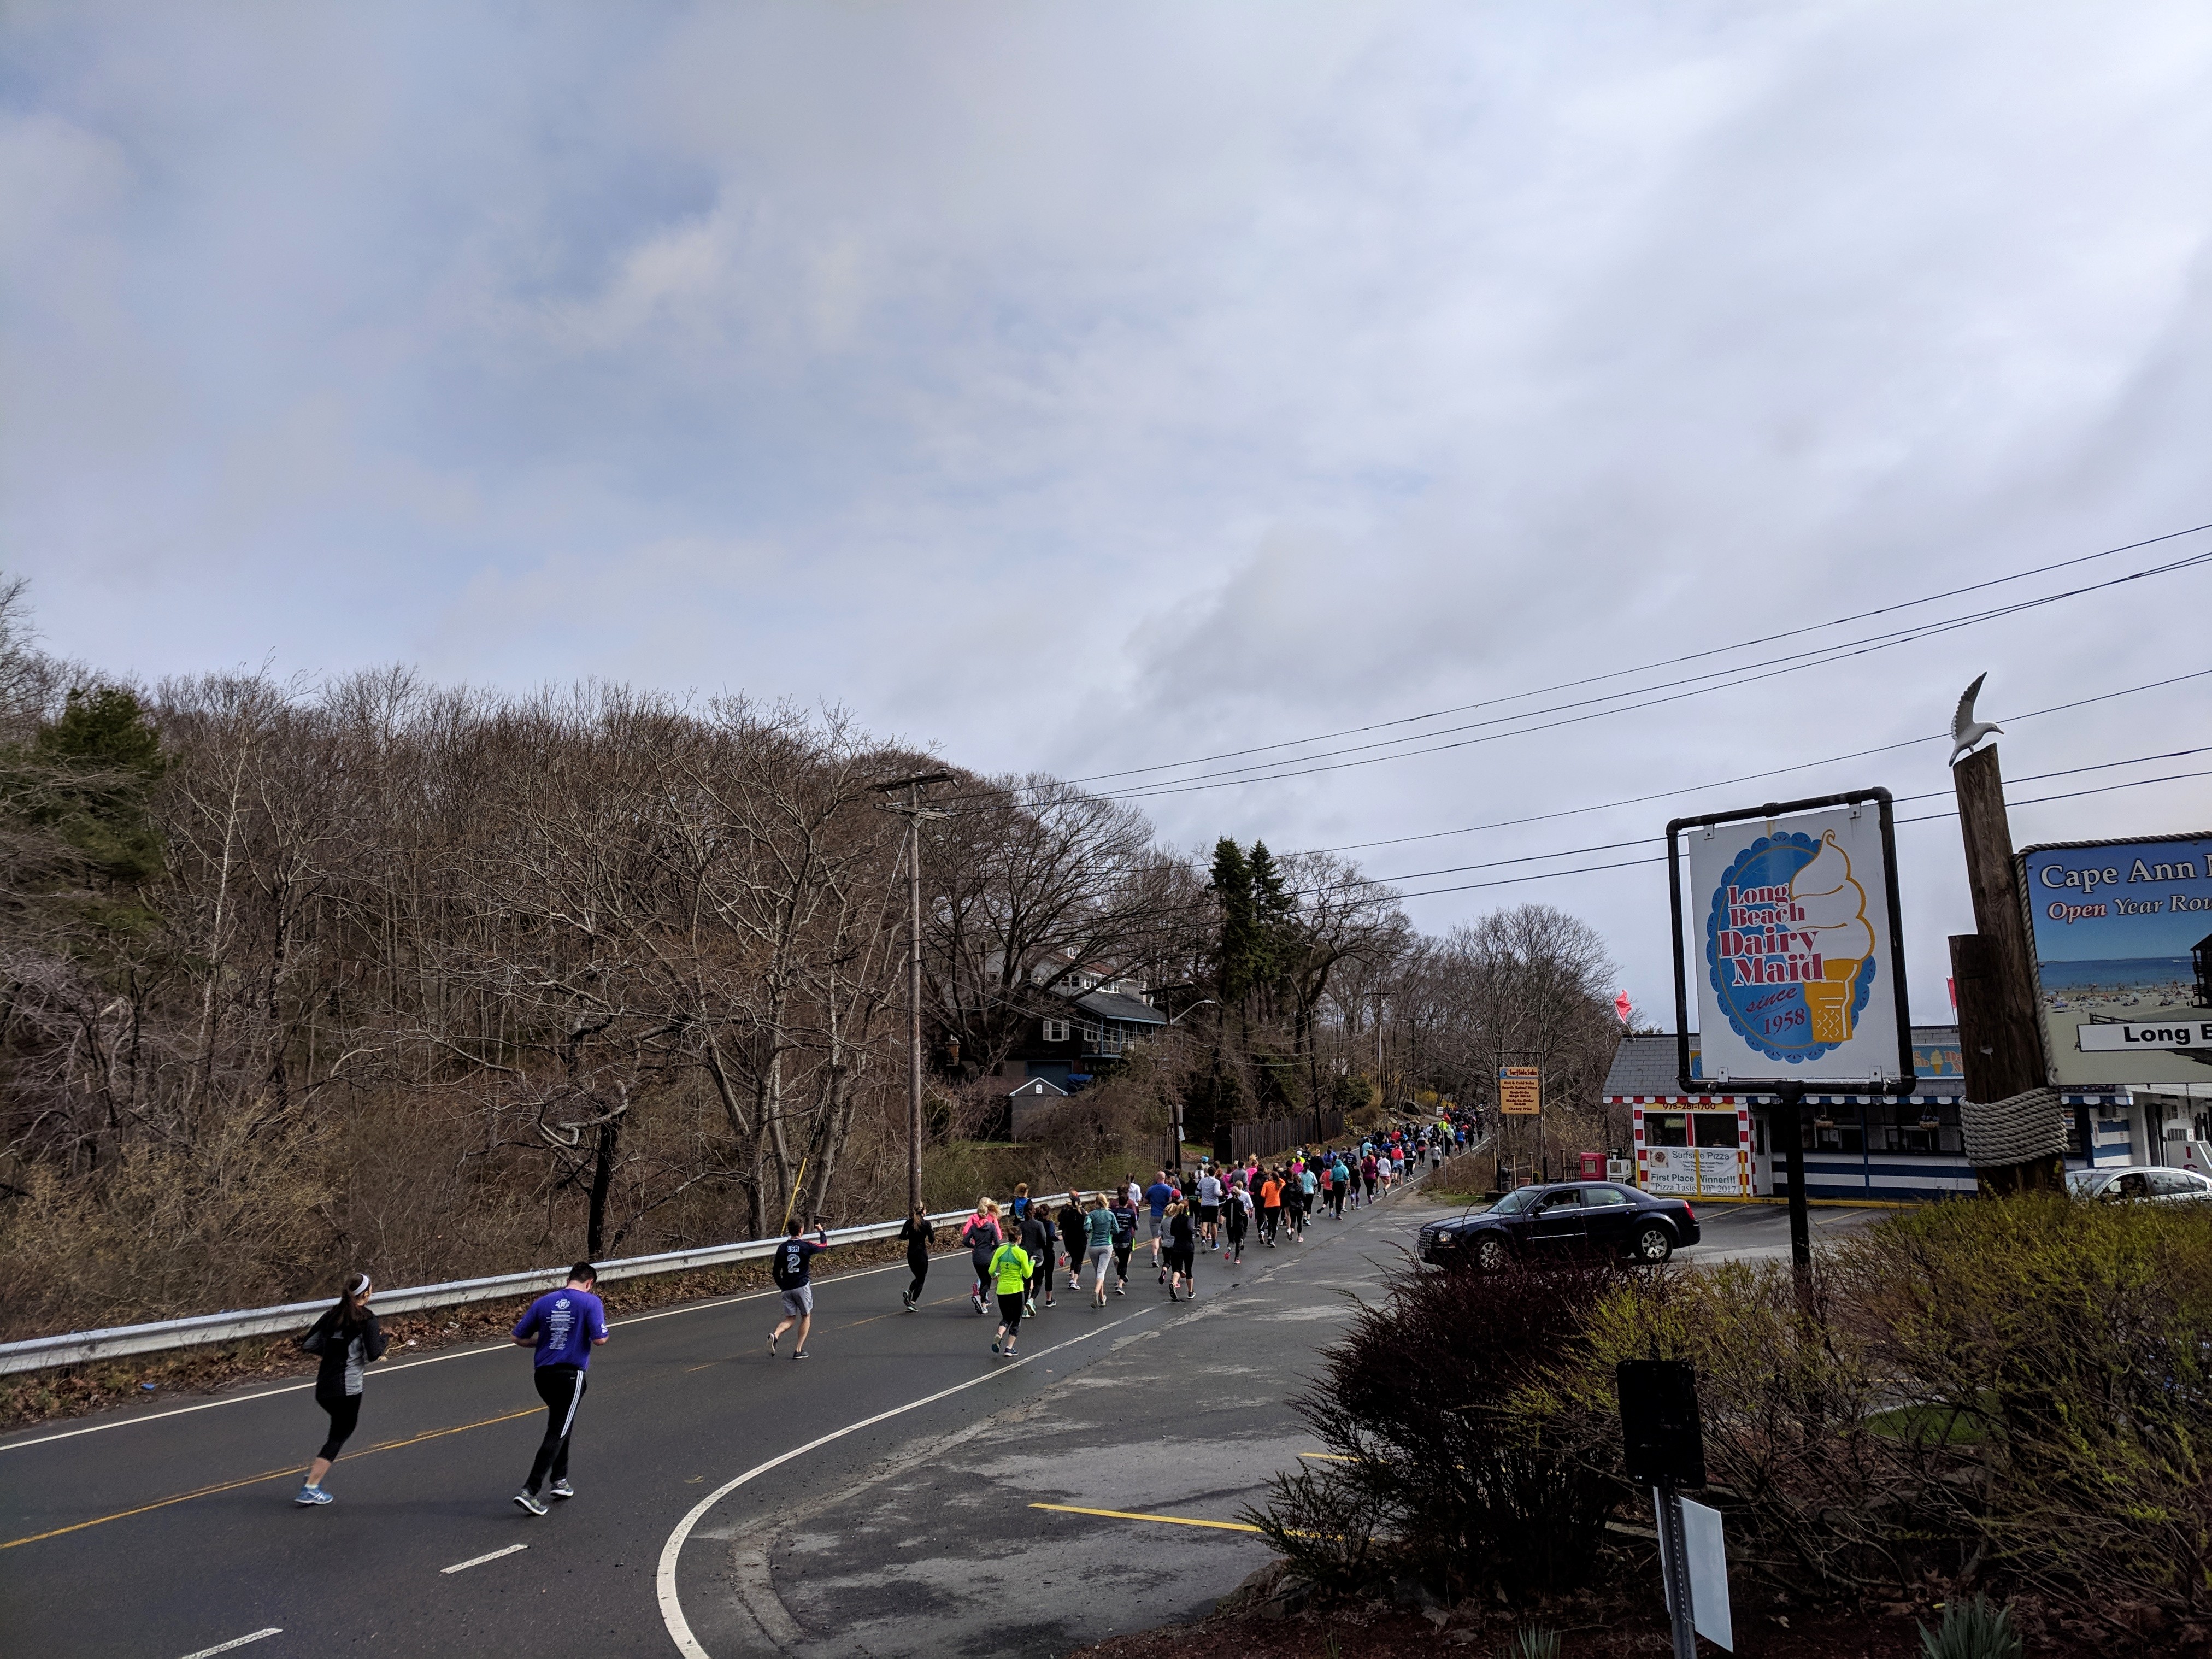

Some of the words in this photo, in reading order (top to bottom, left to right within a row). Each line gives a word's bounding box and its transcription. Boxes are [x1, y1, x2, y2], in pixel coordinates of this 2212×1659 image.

[2041, 865, 2119, 893] Cape
[2128, 858, 2197, 882] Ann
[1728, 884, 1789, 907] Long
[1730, 902, 1806, 927] Beach
[2049, 902, 2107, 924] Open
[2114, 898, 2164, 915] Year
[1719, 926, 1820, 961] Dairy
[1733, 952, 1824, 985] Maid
[1745, 987, 1798, 1013] since
[1764, 1008, 1805, 1036] 1958
[2123, 1026, 2191, 1045] Long
[1672, 1151, 1705, 1159] Surfsie
[1651, 1183, 1674, 1191] "Pizza
[1672, 1174, 1695, 1182] Place
[787, 1254, 801, 1273] 2
